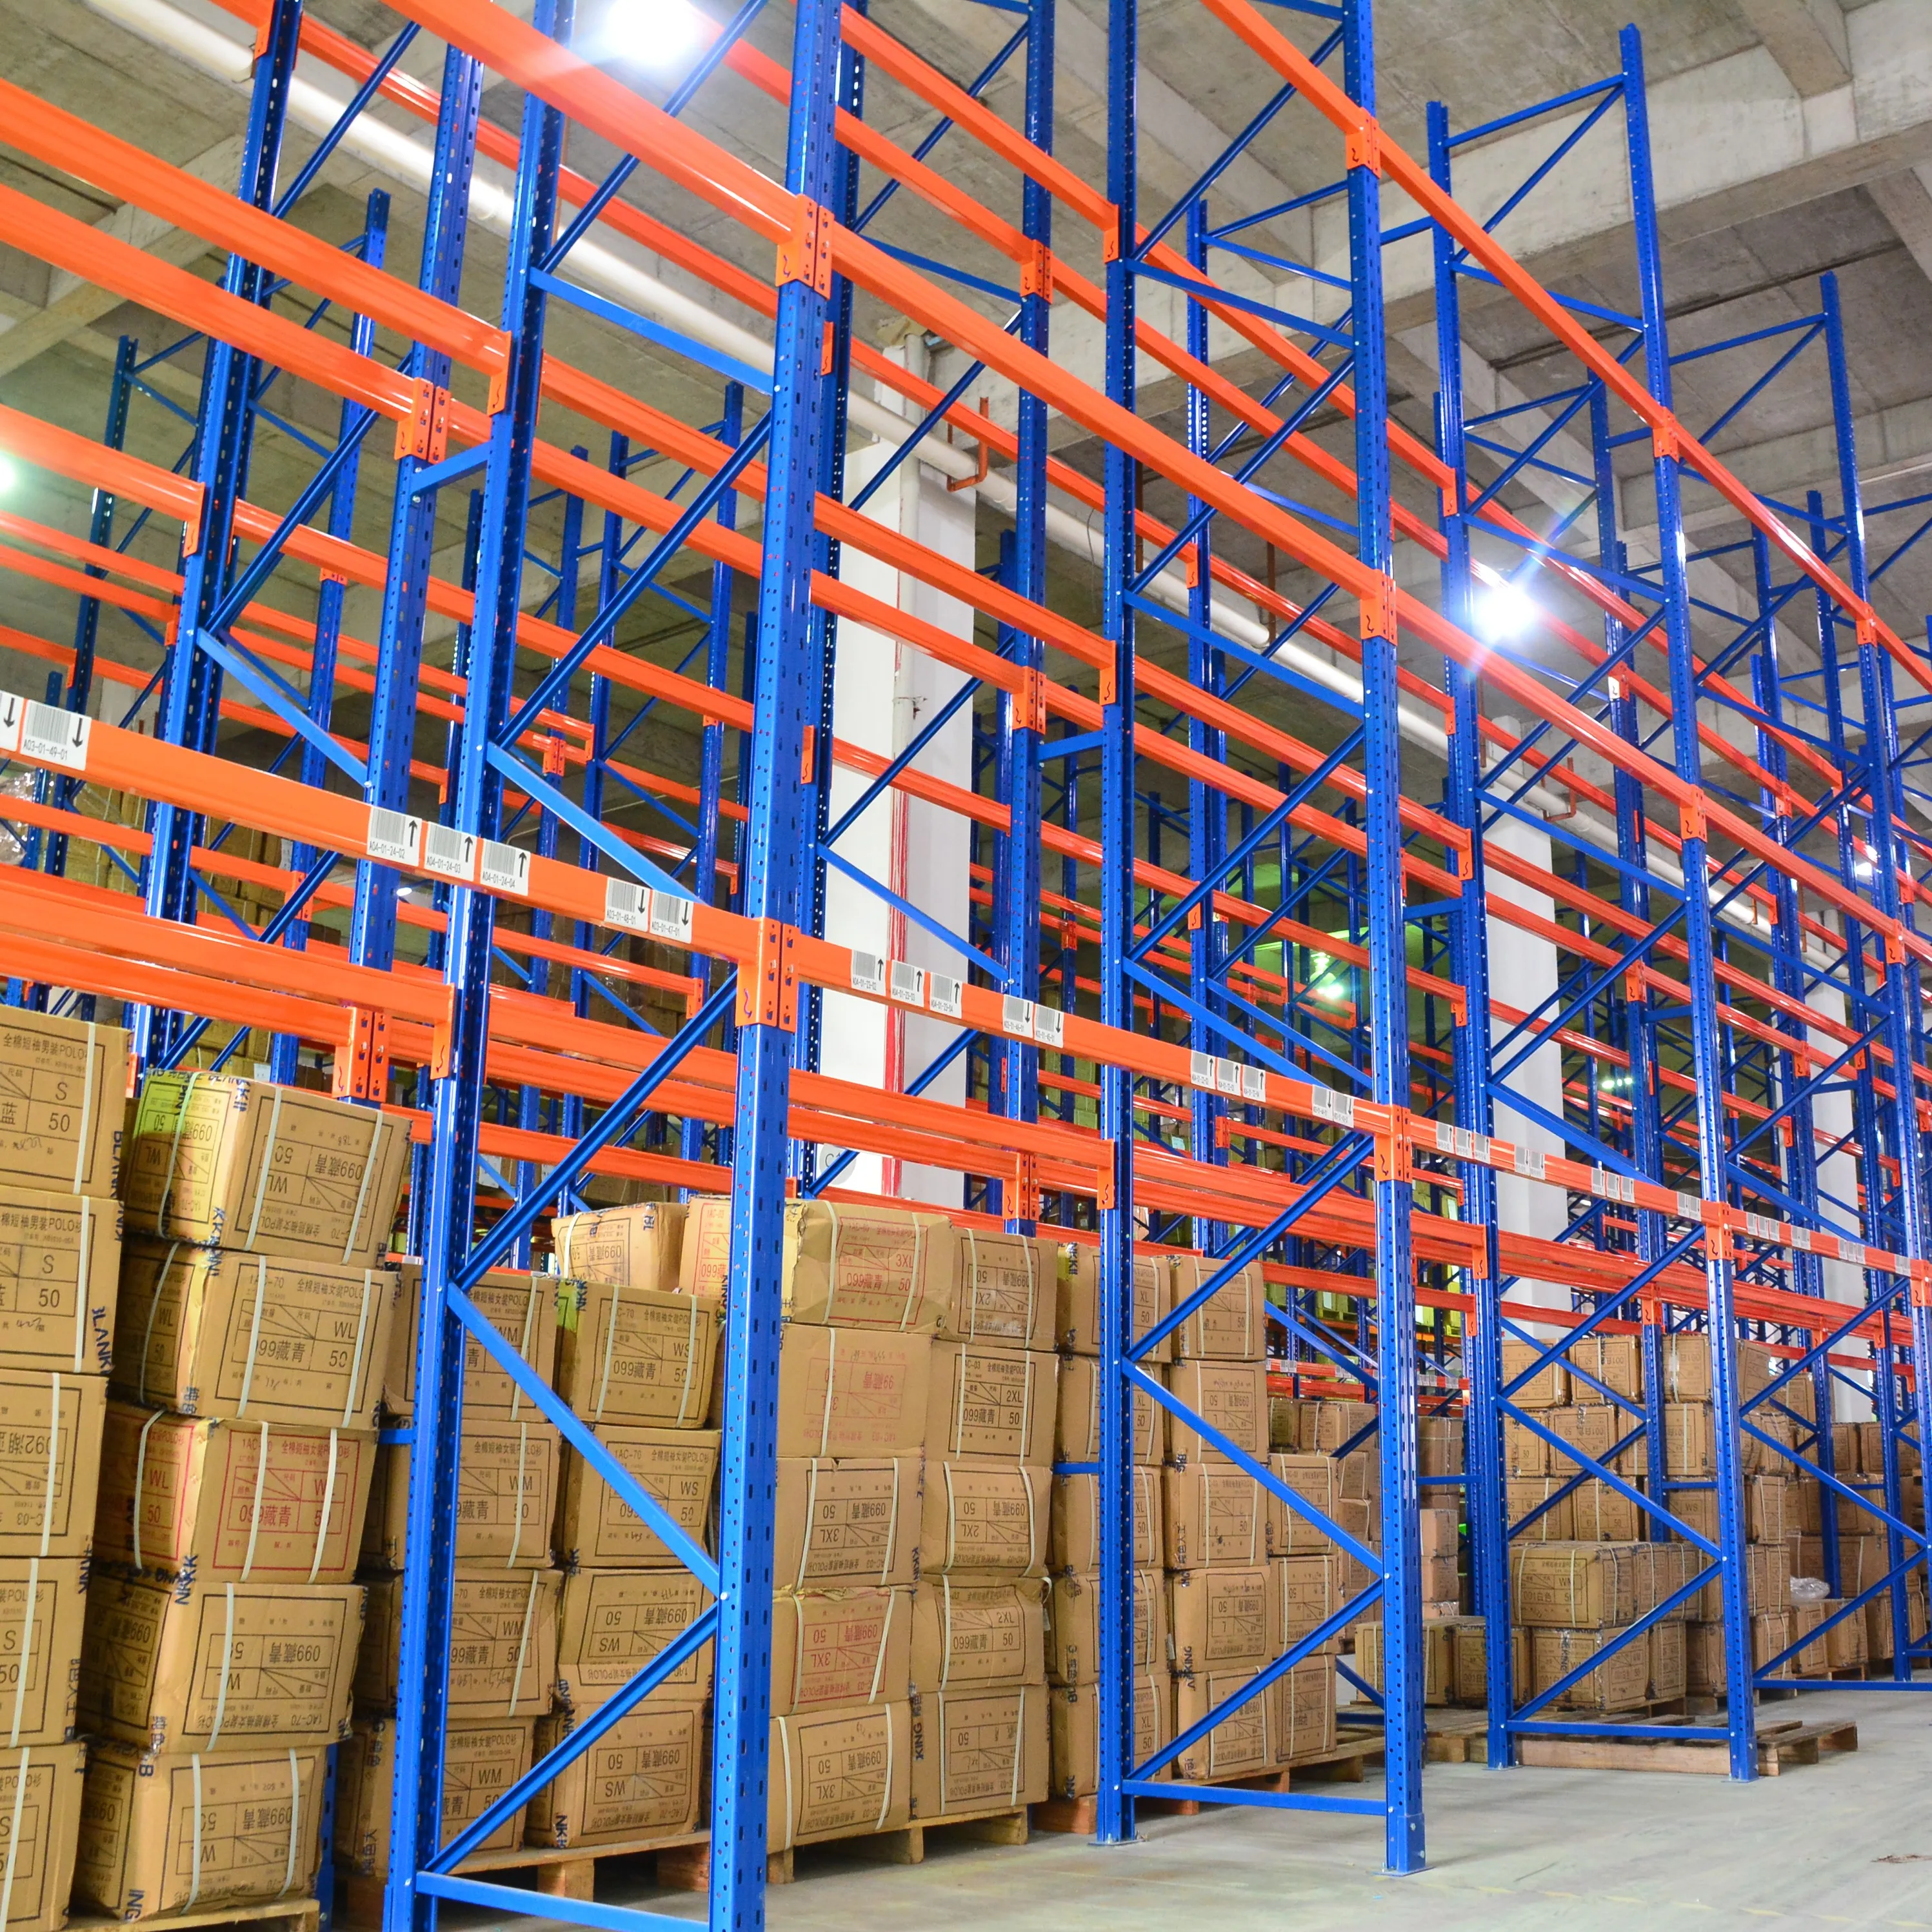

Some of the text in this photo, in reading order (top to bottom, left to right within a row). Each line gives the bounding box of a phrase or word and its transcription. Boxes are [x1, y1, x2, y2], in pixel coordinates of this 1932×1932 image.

[23, 739, 68, 761] A03-01-49-01
[369, 841, 405, 859] A04-01-24-02
[426, 856, 461, 873] A04-01-24-03
[483, 871, 515, 888] A04-01-24-04
[607, 909, 636, 925] A03-01-48-01
[3, 1033, 88, 1061] 全棉短袖男装POLO
[56, 1082, 68, 1100] S
[0, 1101, 18, 1125] 蓝
[48, 1112, 70, 1132] 50
[146, 1146, 161, 1166] WL
[275, 1145, 294, 1164] 50
[315, 1153, 364, 1180] 099藏青
[268, 1174, 287, 1194] WL
[331, 1228, 360, 1242] 1C-70
[42, 1255, 54, 1274] S
[896, 1253, 913, 1268] 3XL
[250, 1273, 284, 1289] 1-70
[846, 1273, 883, 1290] 099藏青
[898, 1278, 911, 1291] 50
[977, 1270, 988, 1283] 50
[1003, 1271, 1030, 1288] 099藏青
[38, 1288, 60, 1308] 50
[1140, 1291, 1149, 1302] XL
[609, 1308, 634, 1319] 1C-70
[1141, 1311, 1150, 1323] 50
[334, 1320, 355, 1340] WL
[1237, 1317, 1245, 1328] 50
[256, 1339, 305, 1363] 99藏青
[329, 1350, 348, 1368] 50
[468, 1348, 480, 1368] 青
[613, 1360, 656, 1380] 099藏青
[674, 1368, 688, 1383] 50
[821, 1395, 839, 1411] 3L
[1006, 1390, 1022, 1403] 2XL
[1137, 1395, 1146, 1406] XL
[1210, 1394, 1218, 1406] 50
[963, 1409, 995, 1424] 099藏青
[1009, 1412, 1020, 1425] 50
[1137, 1415, 1145, 1426] 50
[243, 1438, 272, 1453] 1AC-0
[474, 1440, 542, 1456] 全棉短袖女装PLO衫
[150, 1469, 168, 1489] WL
[681, 1481, 699, 1496] WS
[148, 1504, 161, 1523] 50
[681, 1507, 693, 1522] 50
[822, 1505, 836, 1519] 50
[851, 1502, 886, 1520] 099藏青
[964, 1502, 975, 1515] 50
[993, 1501, 1025, 1516] 099藏青
[1135, 1501, 1144, 1513] XL
[17, 1511, 55, 1526] 1C-03
[1240, 1520, 1247, 1531] 50
[820, 1528, 840, 1543] 3XL
[961, 1524, 979, 1538] 2XL
[1138, 1522, 1146, 1533] 50
[1523, 1590, 1551, 1602] 001白色
[1219, 1600, 1227, 1613] 50
[606, 1611, 622, 1626] 50
[644, 1608, 687, 1625] 099藏青
[997, 1612, 1015, 1623] 2XL
[503, 1620, 524, 1636] WM
[813, 1629, 826, 1643] 50
[844, 1624, 878, 1642] 099藏青
[4, 1629, 16, 1650] S
[599, 1637, 620, 1652] WS
[953, 1633, 988, 1649] 099藏青
[1002, 1633, 1013, 1646] 50
[269, 1642, 321, 1664] 099藏青
[506, 1646, 520, 1662] 50
[811, 1652, 830, 1668] 3XL
[291, 1714, 322, 1727] 1AC-70
[1141, 1717, 1151, 1728] XL
[913, 1722, 924, 1761] KING
[958, 1733, 969, 1746] 50
[1143, 1737, 1152, 1749] 50
[608, 1754, 623, 1770] 50
[642, 1749, 680, 1769] 099藏青
[818, 1760, 831, 1774] 50
[848, 1750, 881, 1771] 099藏青
[479, 1768, 502, 1784] WM
[605, 1780, 625, 1797] WS
[817, 1784, 836, 1800] 3XL
[0, 1816, 10, 1837] S
